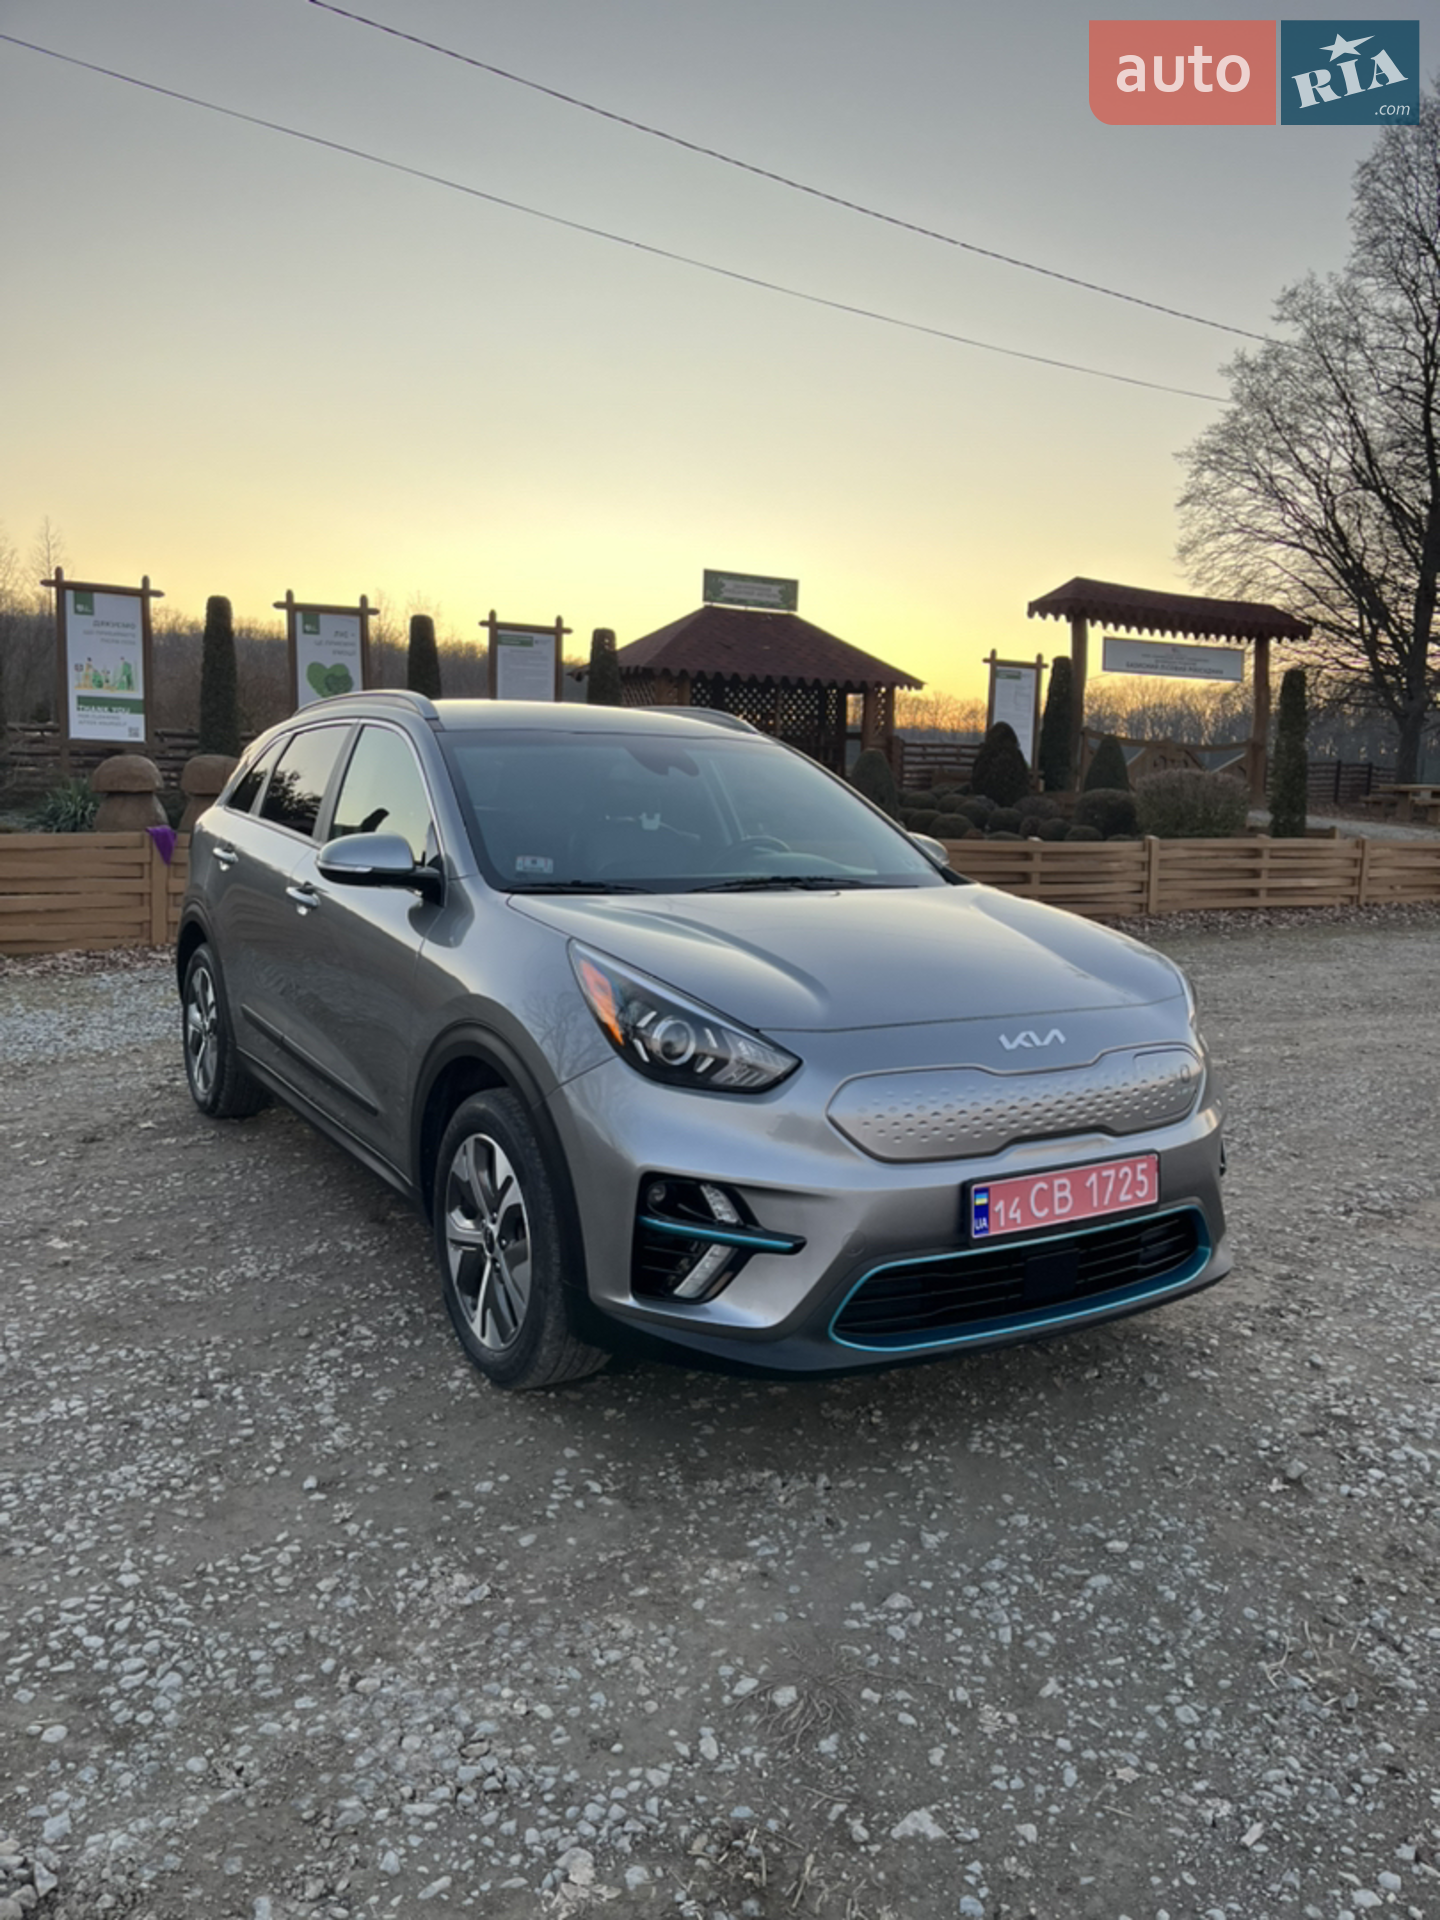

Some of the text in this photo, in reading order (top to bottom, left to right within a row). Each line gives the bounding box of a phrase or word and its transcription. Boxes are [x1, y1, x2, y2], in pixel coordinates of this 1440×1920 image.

[994, 1162, 1149, 1227] 14 CB 1725
[974, 1217, 988, 1231] UA
